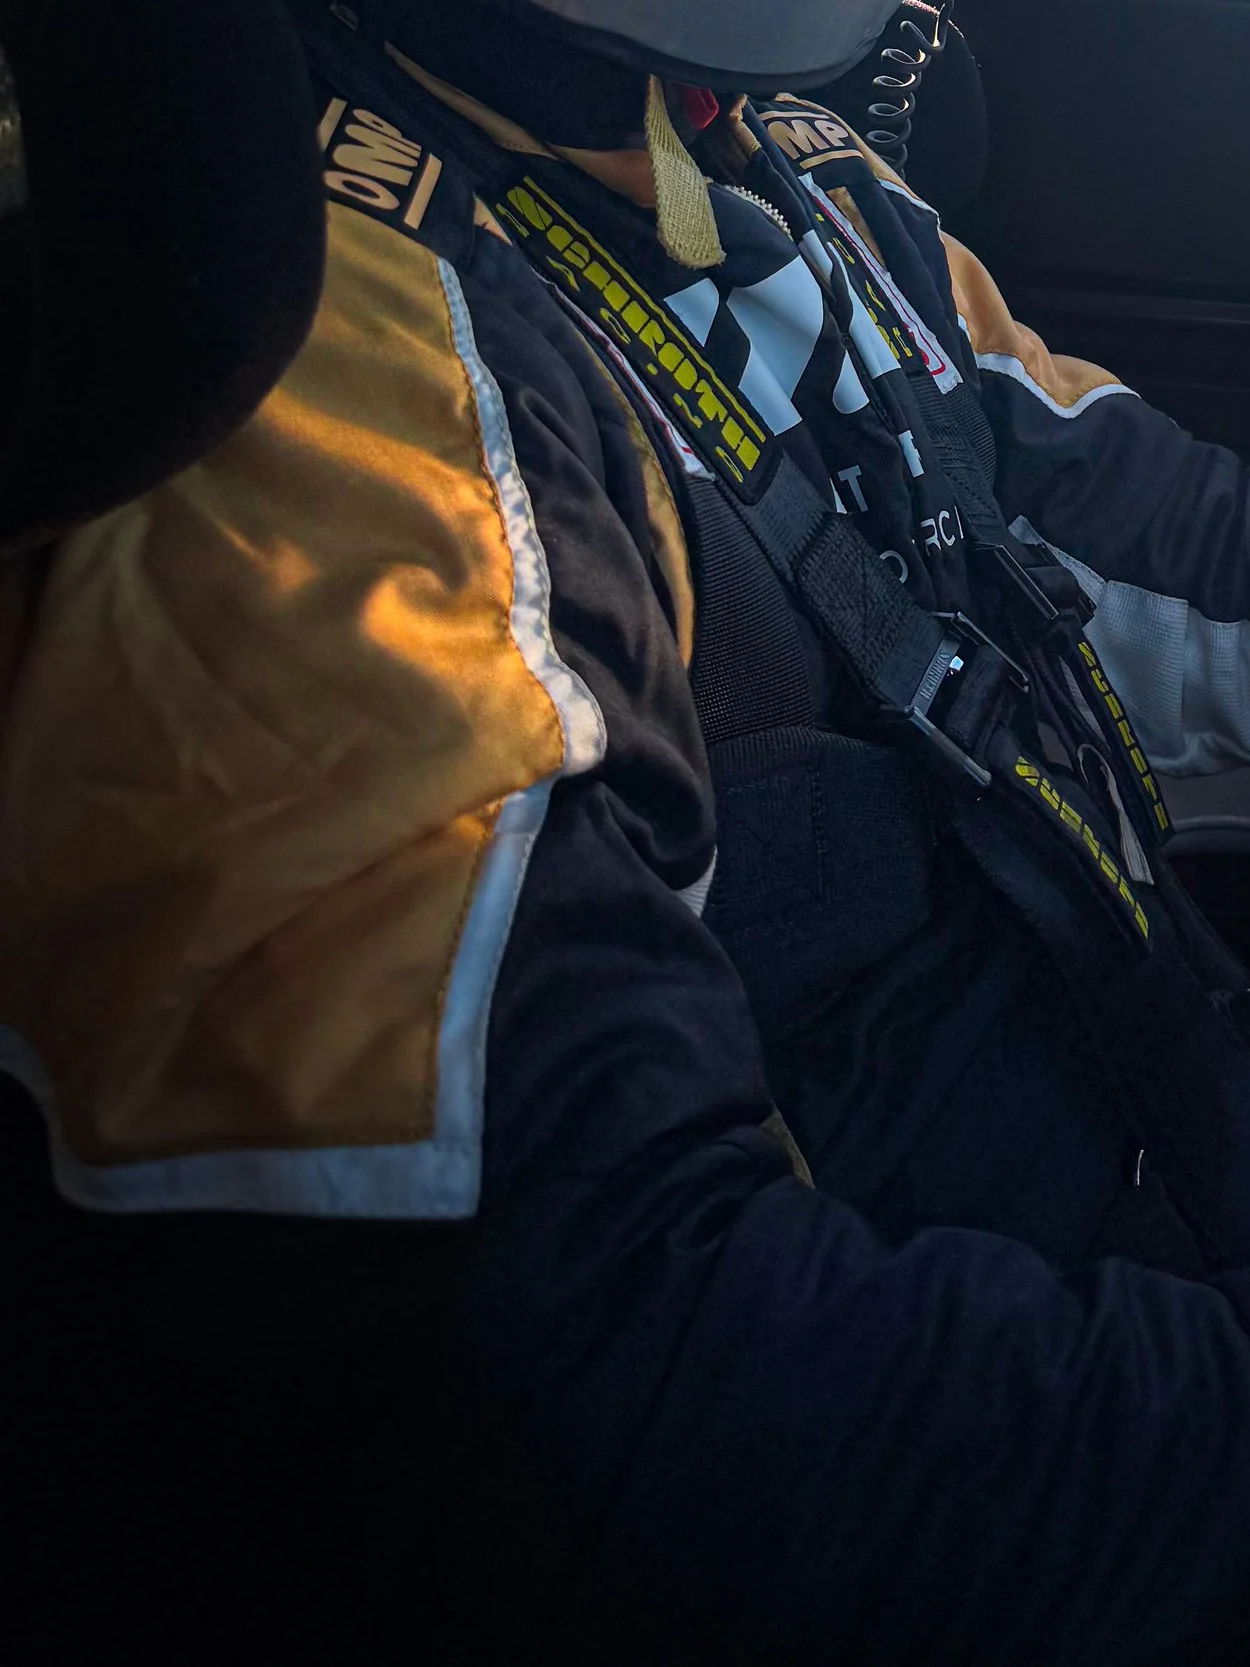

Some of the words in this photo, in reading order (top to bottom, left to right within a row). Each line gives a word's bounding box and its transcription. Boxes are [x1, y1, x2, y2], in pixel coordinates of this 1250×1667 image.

[318, 109, 422, 210] OMP
[767, 119, 848, 161] MP
[506, 185, 761, 471] SCHROTH
